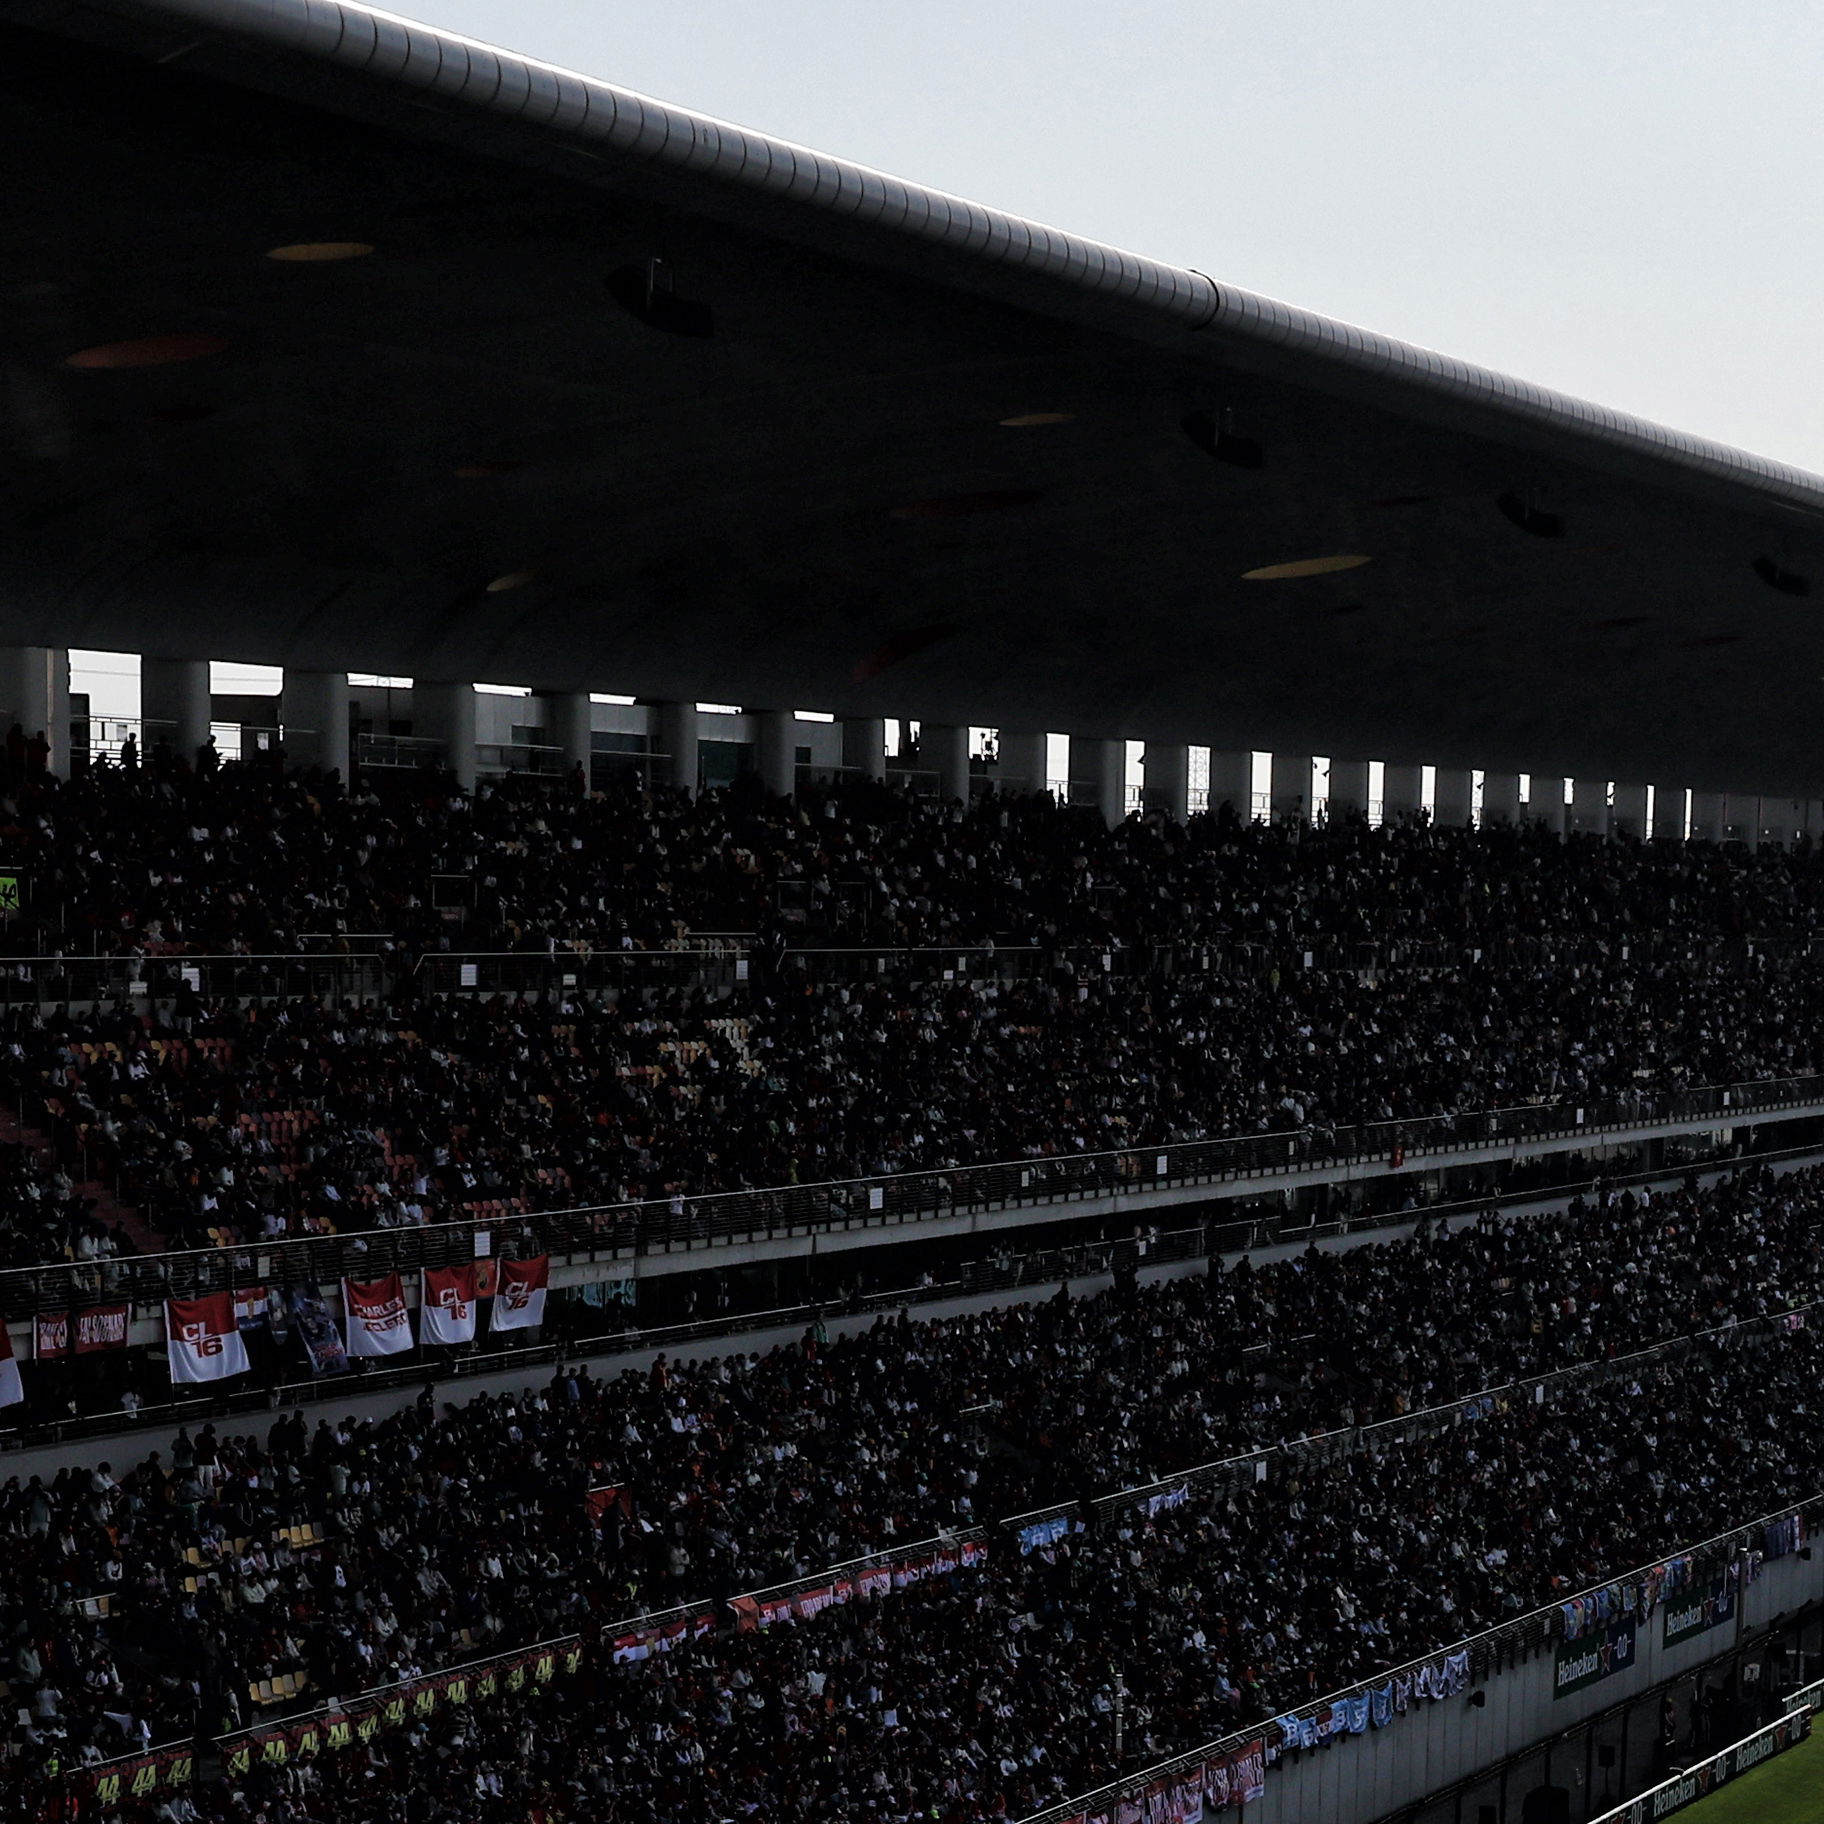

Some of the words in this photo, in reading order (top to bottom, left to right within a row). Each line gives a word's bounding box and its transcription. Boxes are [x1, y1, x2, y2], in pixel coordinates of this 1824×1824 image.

[182, 1321, 208, 1341] CL
[193, 1337, 222, 1359] 16
[1666, 1605, 1702, 1637] Heineken
[1558, 1651, 1598, 1687] Heineken
[131, 1764, 157, 1797] 44
[167, 1757, 192, 1787] 44
[1654, 1776, 1695, 1817] Heineken
